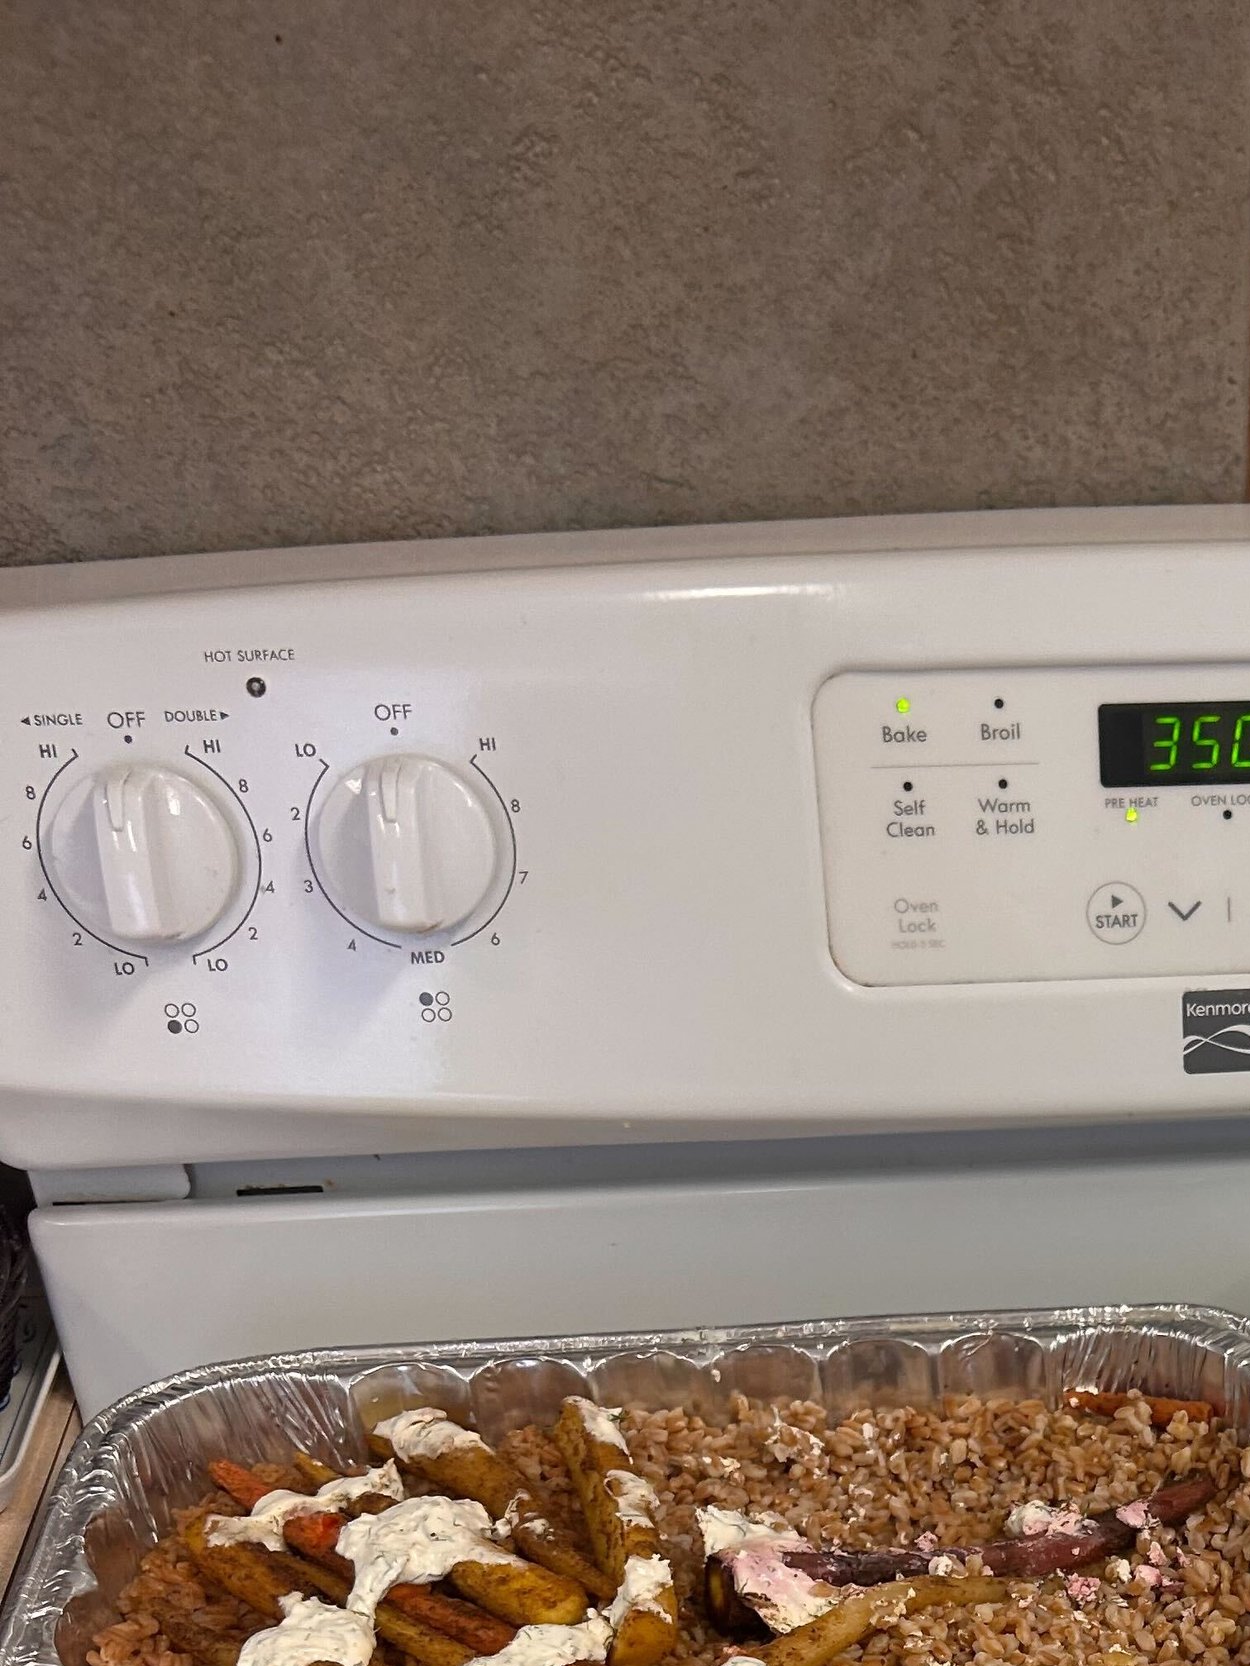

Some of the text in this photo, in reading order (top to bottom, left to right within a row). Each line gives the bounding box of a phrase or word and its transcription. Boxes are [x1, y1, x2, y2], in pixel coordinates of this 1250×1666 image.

[203, 648, 295, 663] HOT SURFACE
[33, 713, 83, 727] SINGLE
[107, 711, 146, 729] OFF
[164, 709, 219, 724] DOUBLE
[374, 704, 413, 721] OFF
[882, 725, 928, 743] Bake
[980, 722, 1021, 741] Broil
[203, 740, 221, 754] HI
[294, 743, 316, 758] LO
[479, 737, 497, 751] HI
[39, 744, 57, 760] HI
[25, 785, 36, 800] 8
[238, 779, 249, 793] 8
[510, 800, 521, 814] 8
[893, 799, 927, 817] Self
[978, 798, 1031, 813] Warm
[1104, 796, 1158, 809] PRE HEAT
[1191, 795, 1227, 807] OVEN
[290, 807, 301, 822] 2
[886, 821, 936, 838] Clean
[976, 819, 1035, 836] & Hold
[22, 835, 33, 850] 6
[262, 828, 272, 843] 6
[518, 870, 529, 885] 7
[264, 880, 275, 894] 4
[303, 879, 314, 894] 3
[37, 888, 48, 903] 4
[893, 898, 939, 914] Oven
[899, 918, 937, 934] Lock
[1095, 914, 1138, 929] START
[73, 932, 83, 947] 2
[248, 927, 258, 941] 2
[490, 932, 500, 947] 6
[347, 938, 358, 953] 4
[410, 950, 445, 965] MED
[114, 961, 135, 977] LO
[207, 958, 229, 973] LO
